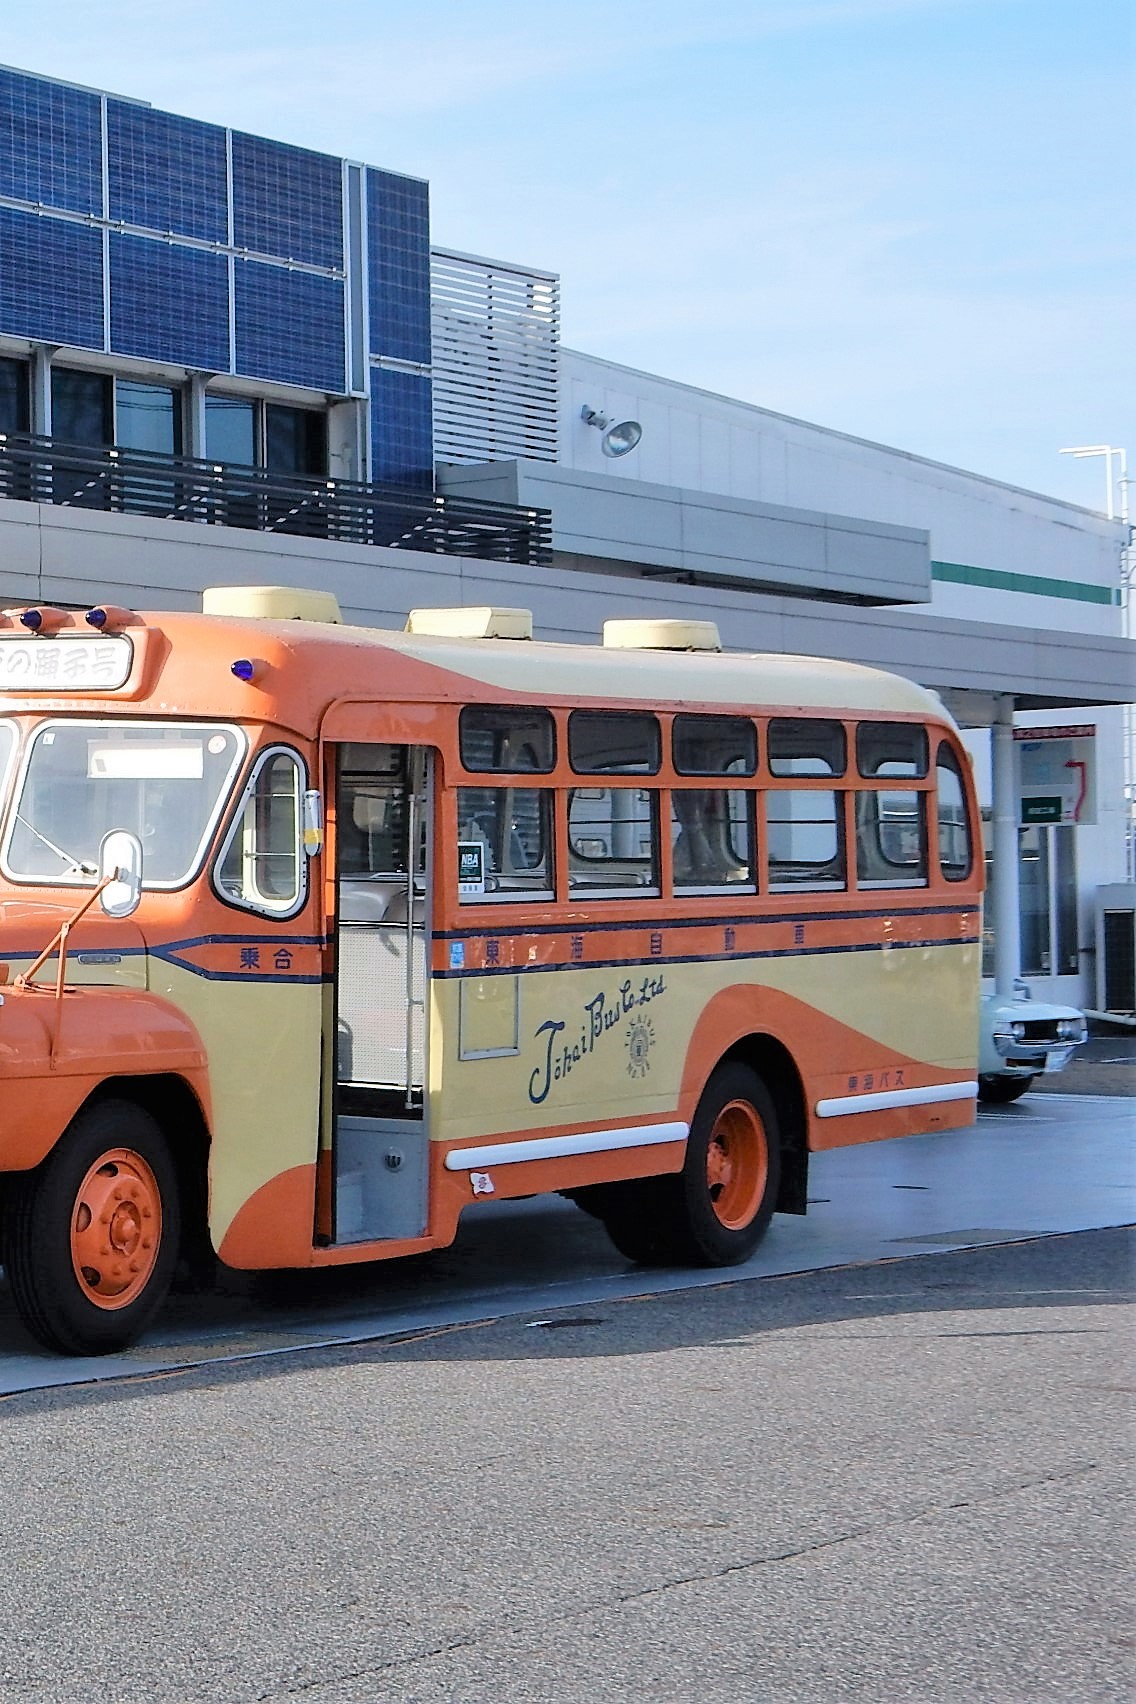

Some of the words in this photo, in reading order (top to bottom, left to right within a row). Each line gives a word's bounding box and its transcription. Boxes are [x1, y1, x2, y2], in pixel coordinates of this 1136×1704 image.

[461, 853, 479, 867] NBA
[239, 947, 294, 970] 乗合
[584, 992, 621, 1053] Bus
